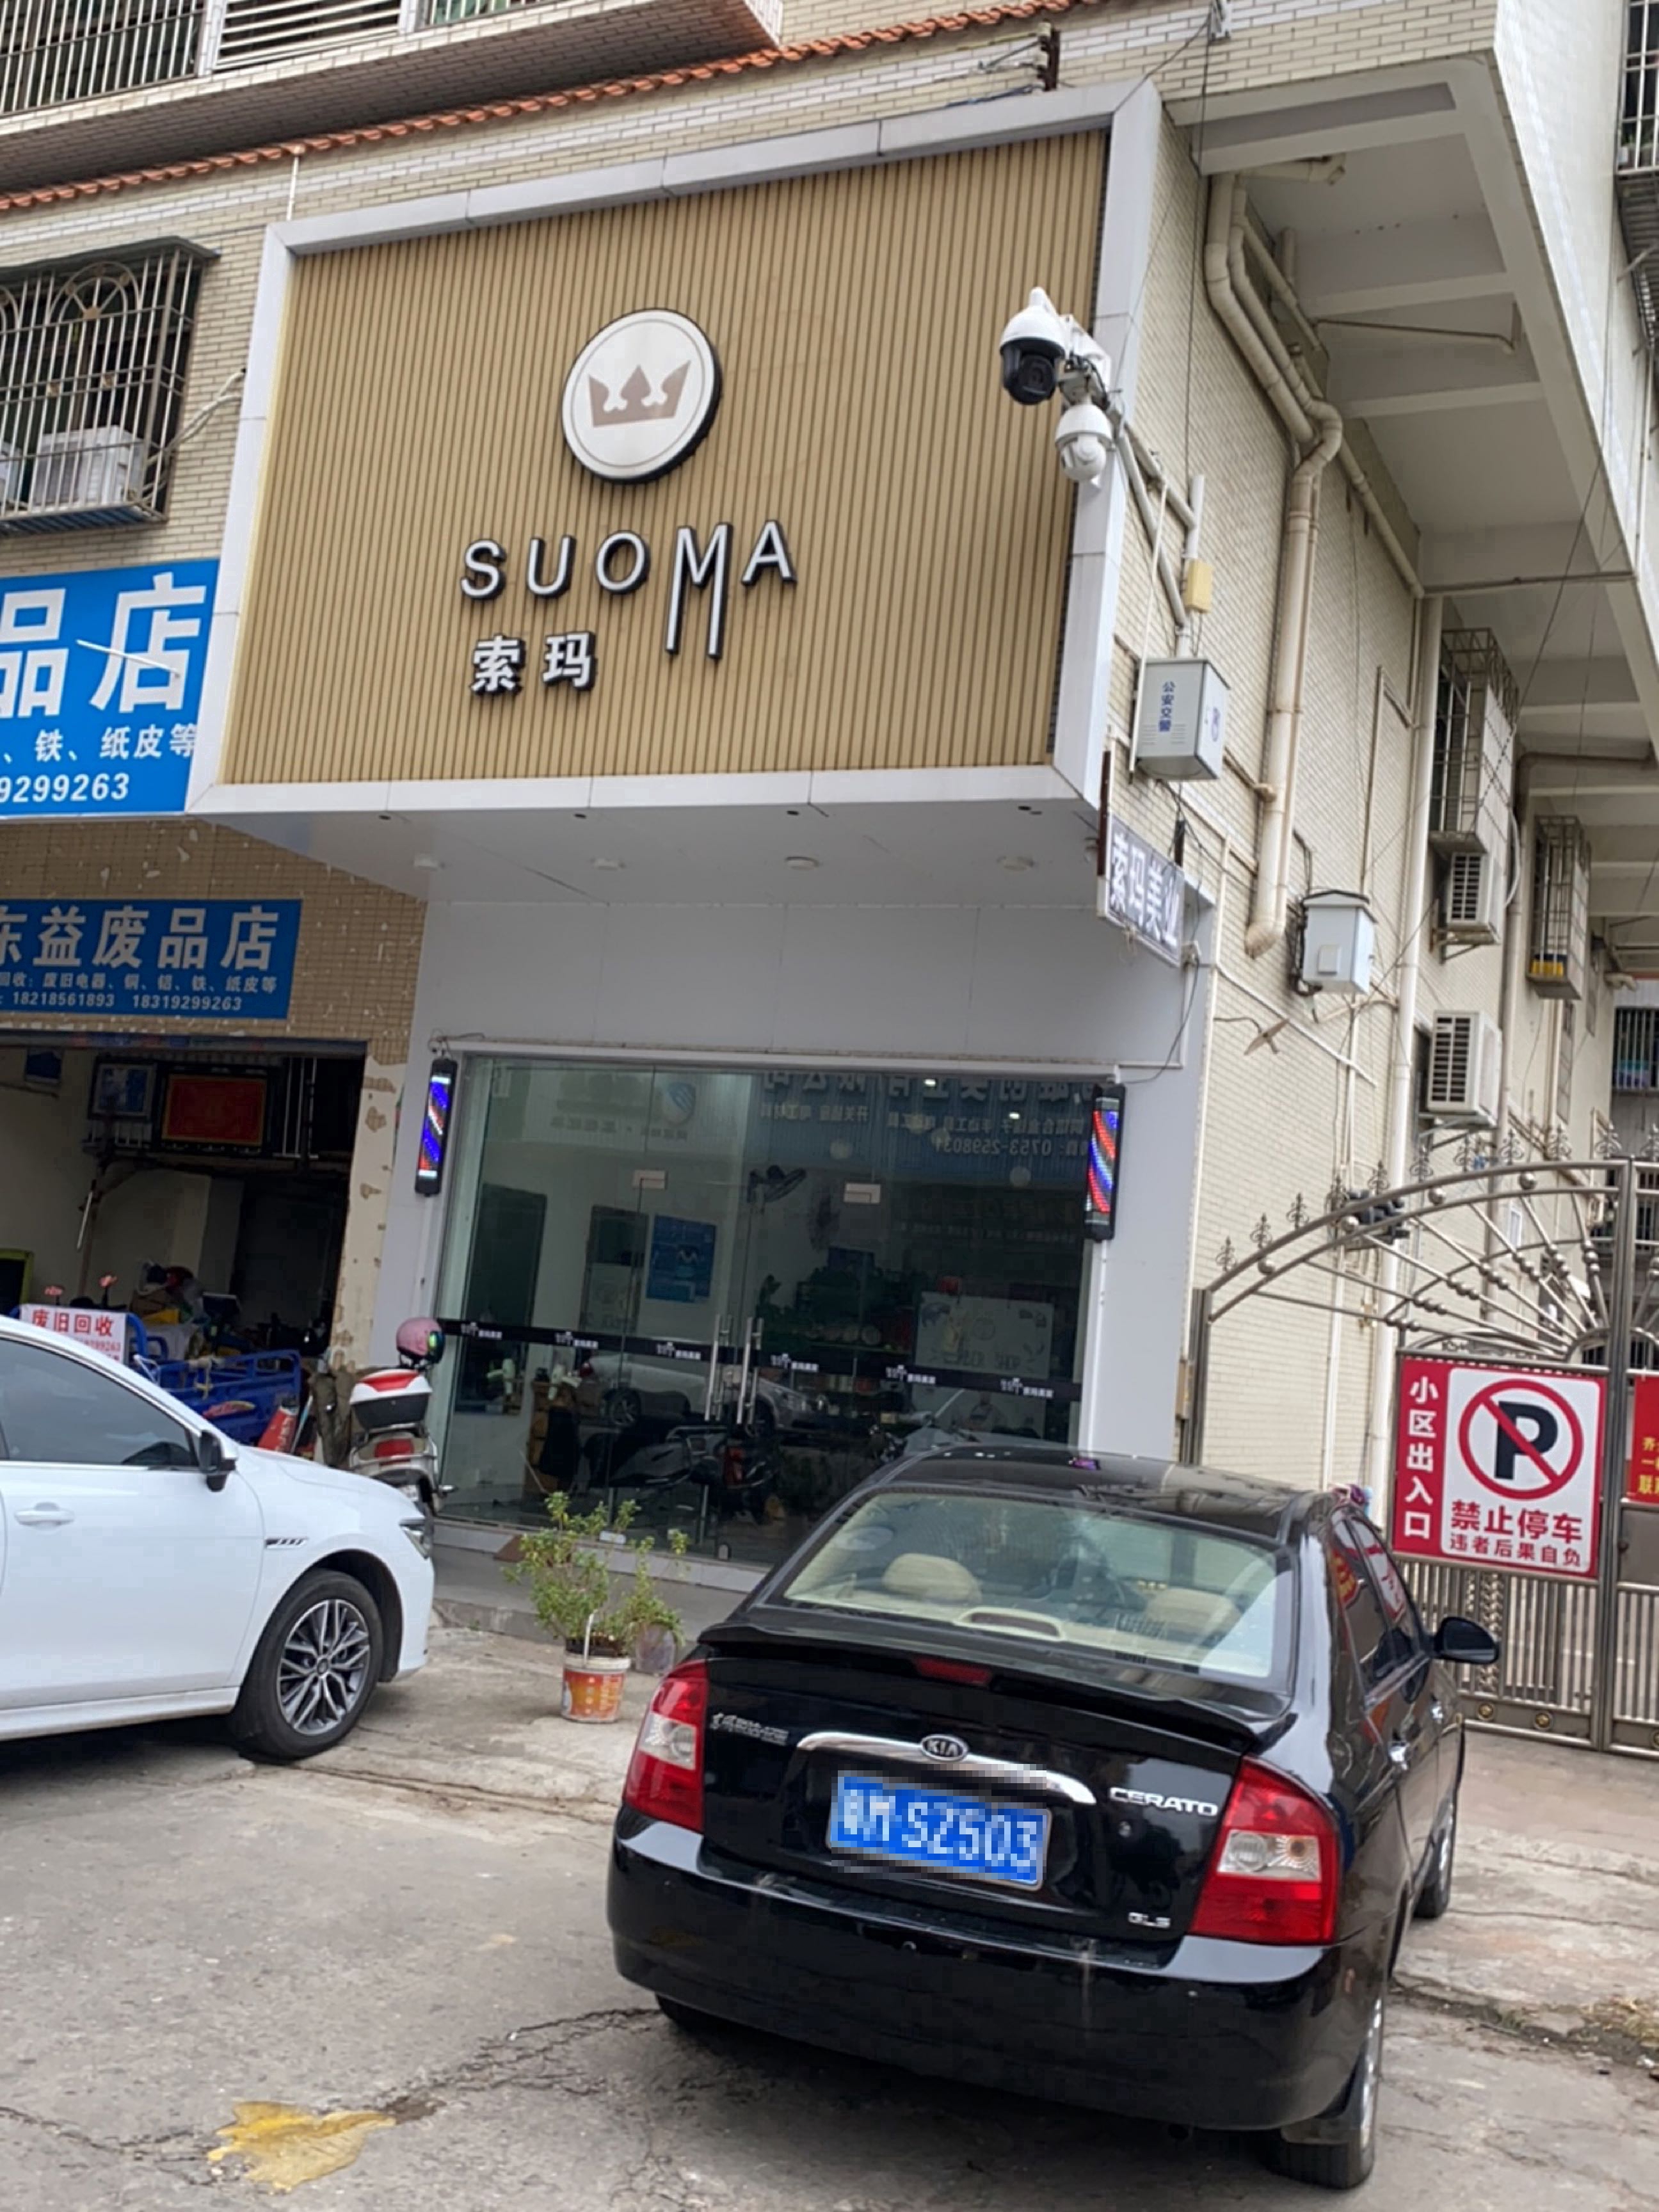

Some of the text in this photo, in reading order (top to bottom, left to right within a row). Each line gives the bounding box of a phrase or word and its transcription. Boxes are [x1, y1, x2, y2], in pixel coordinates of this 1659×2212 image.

[460, 519, 796, 659] SUOMA
[0, 572, 207, 719] 品店
[470, 630, 595, 694] 索玛
[1158, 680, 1176, 733] 公安交警
[0, 773, 130, 803] 9299263
[1110, 831, 1180, 949] 索玛美业
[33, 1309, 113, 1336] 废旧回收
[1404, 1375, 1439, 1539] 小区出入口
[1450, 1498, 1583, 1544] 禁止停车
[1449, 1532, 1582, 1567] 违者后果自负
[927, 1737, 959, 1757] KIA
[1109, 1786, 1219, 1816] CERATO
